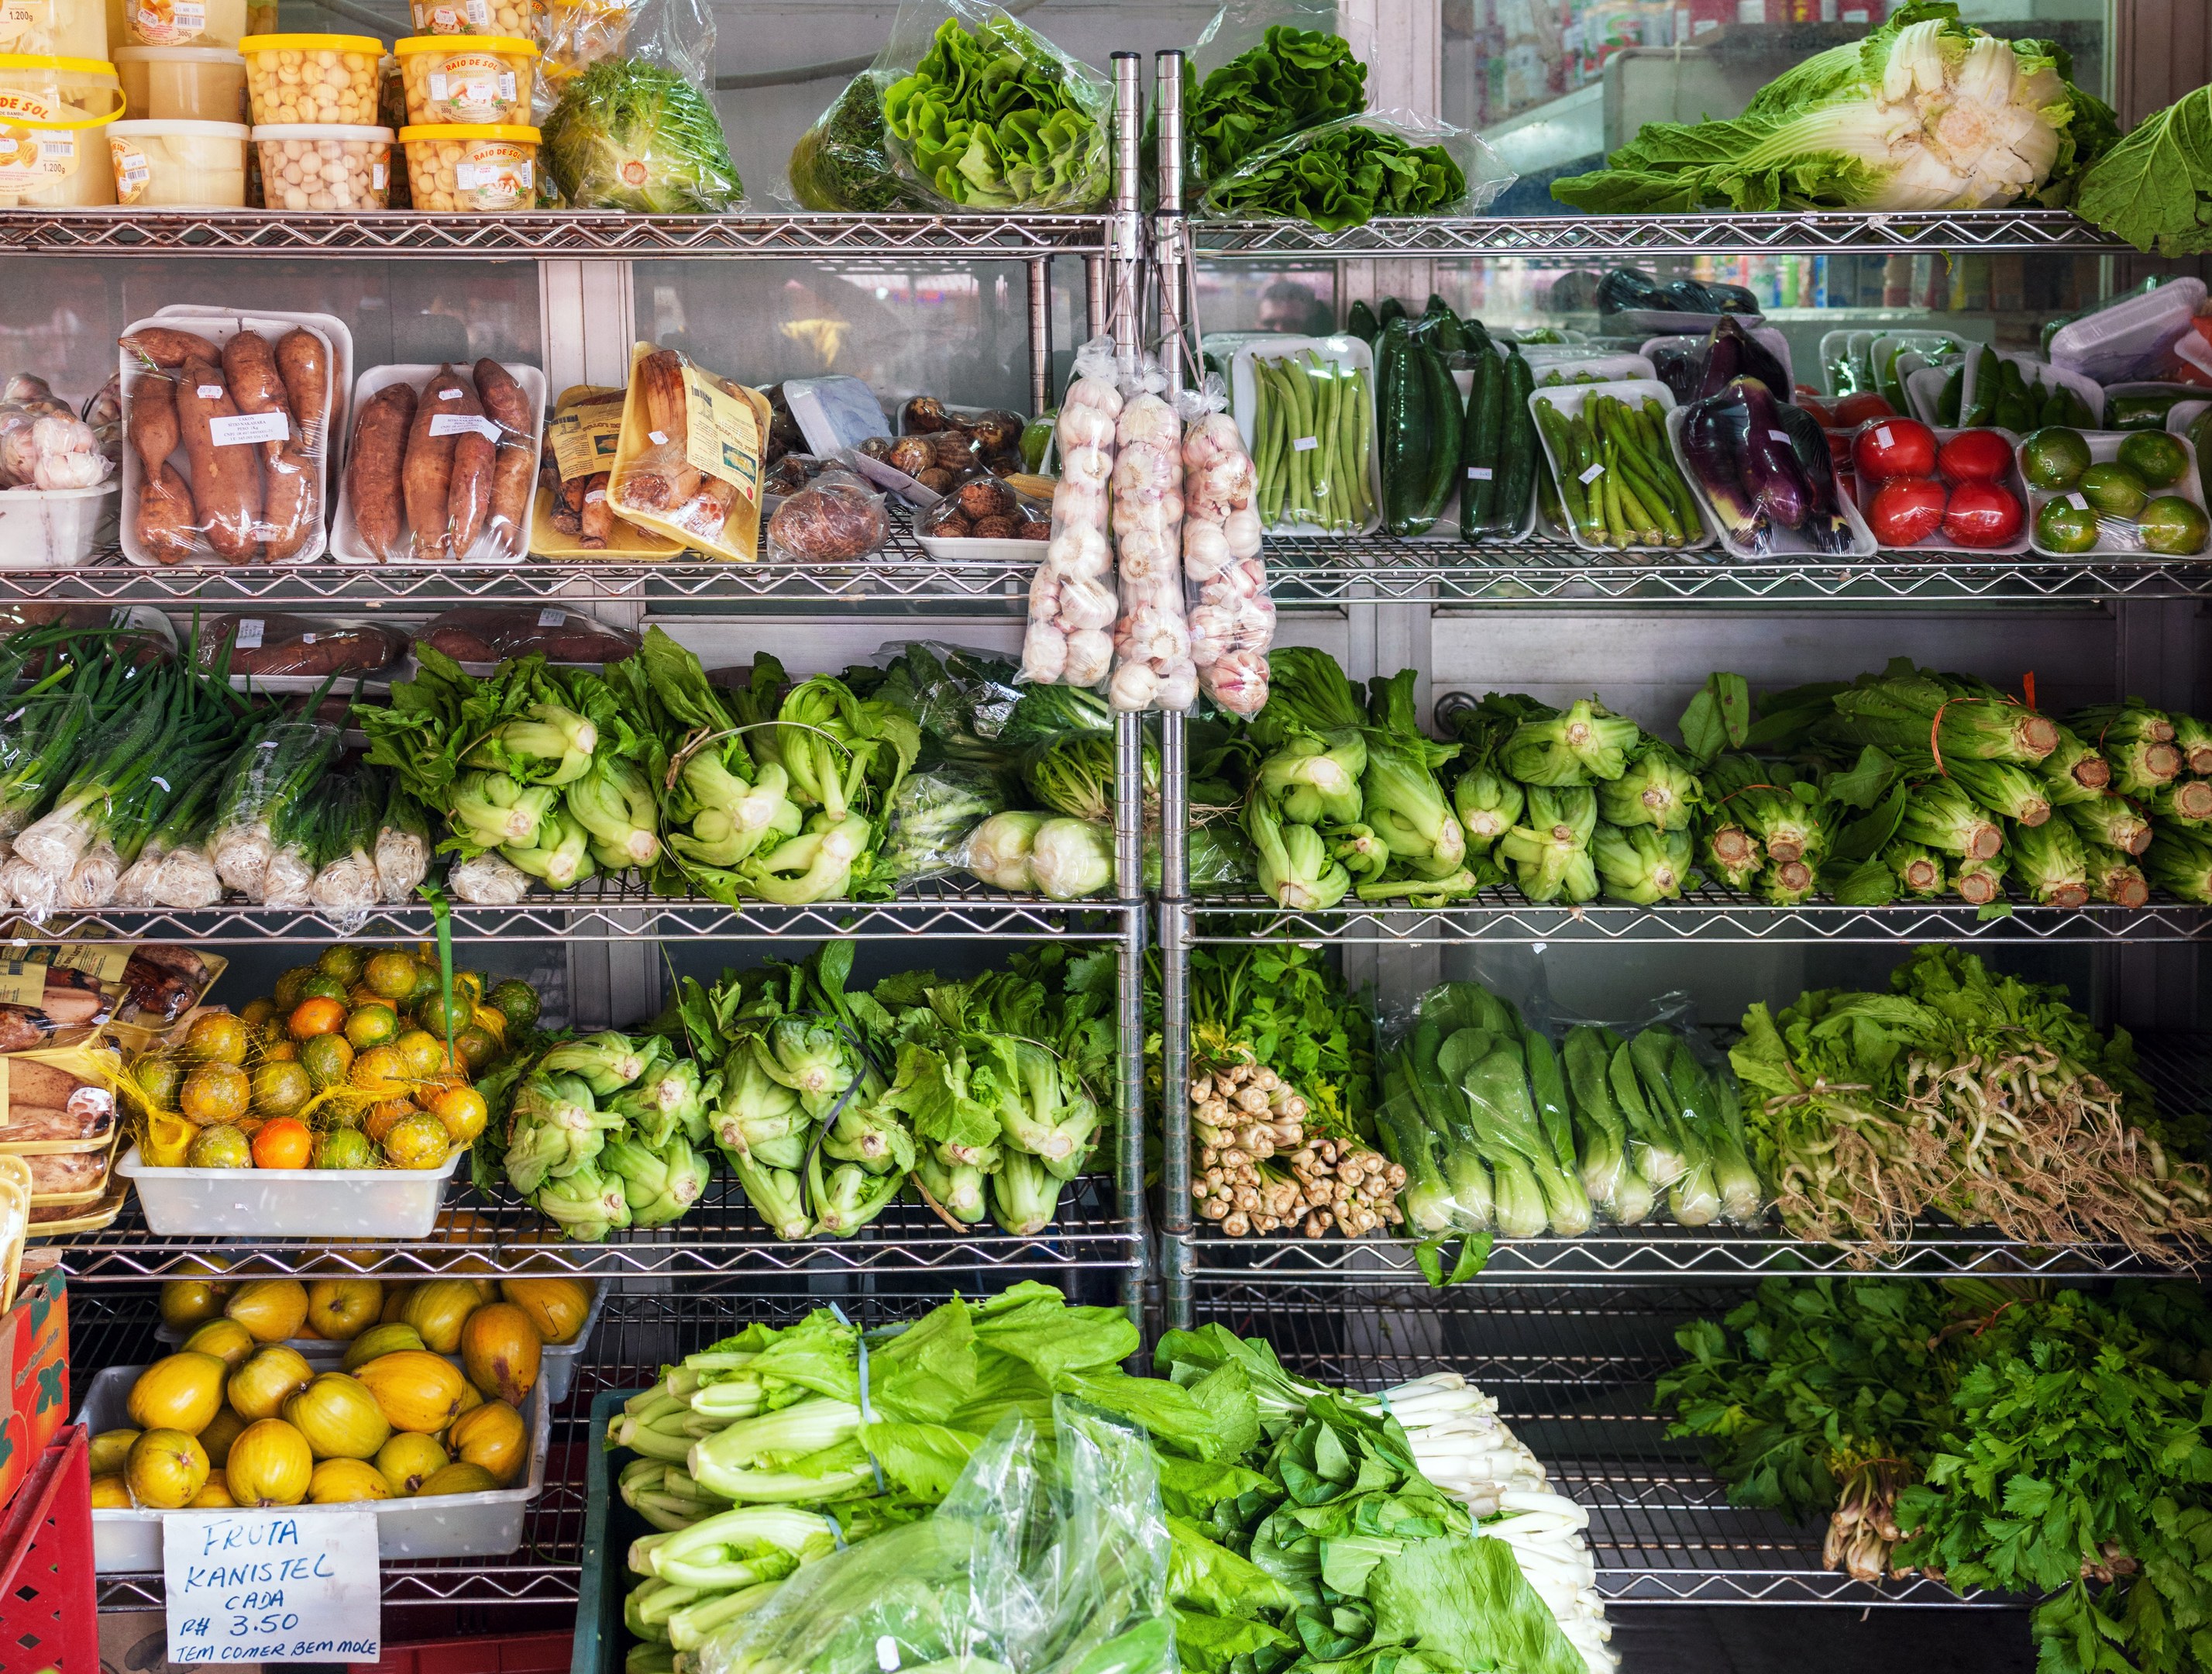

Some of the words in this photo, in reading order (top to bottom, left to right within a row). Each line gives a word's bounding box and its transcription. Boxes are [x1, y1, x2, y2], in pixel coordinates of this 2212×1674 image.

[9, 11, 33, 22] 1.200g
[445, 60, 466, 71] RAIO
[482, 60, 498, 71] SOL
[0, 97, 19, 109] DE
[22, 102, 50, 119] SOL
[473, 150, 494, 161] RAIO
[508, 150, 521, 160] SOL
[43, 163, 65, 174] 1.200g
[202, 1518, 298, 1556] FRUTA
[184, 1552, 335, 1593] KANISTEL
[225, 1589, 284, 1610] CADA
[229, 1614, 299, 1637] 3.50
[176, 1645, 215, 1663] TEM
[221, 1642, 285, 1660] COMER
[290, 1640, 334, 1657] BEM
[336, 1638, 378, 1655] MOLE
